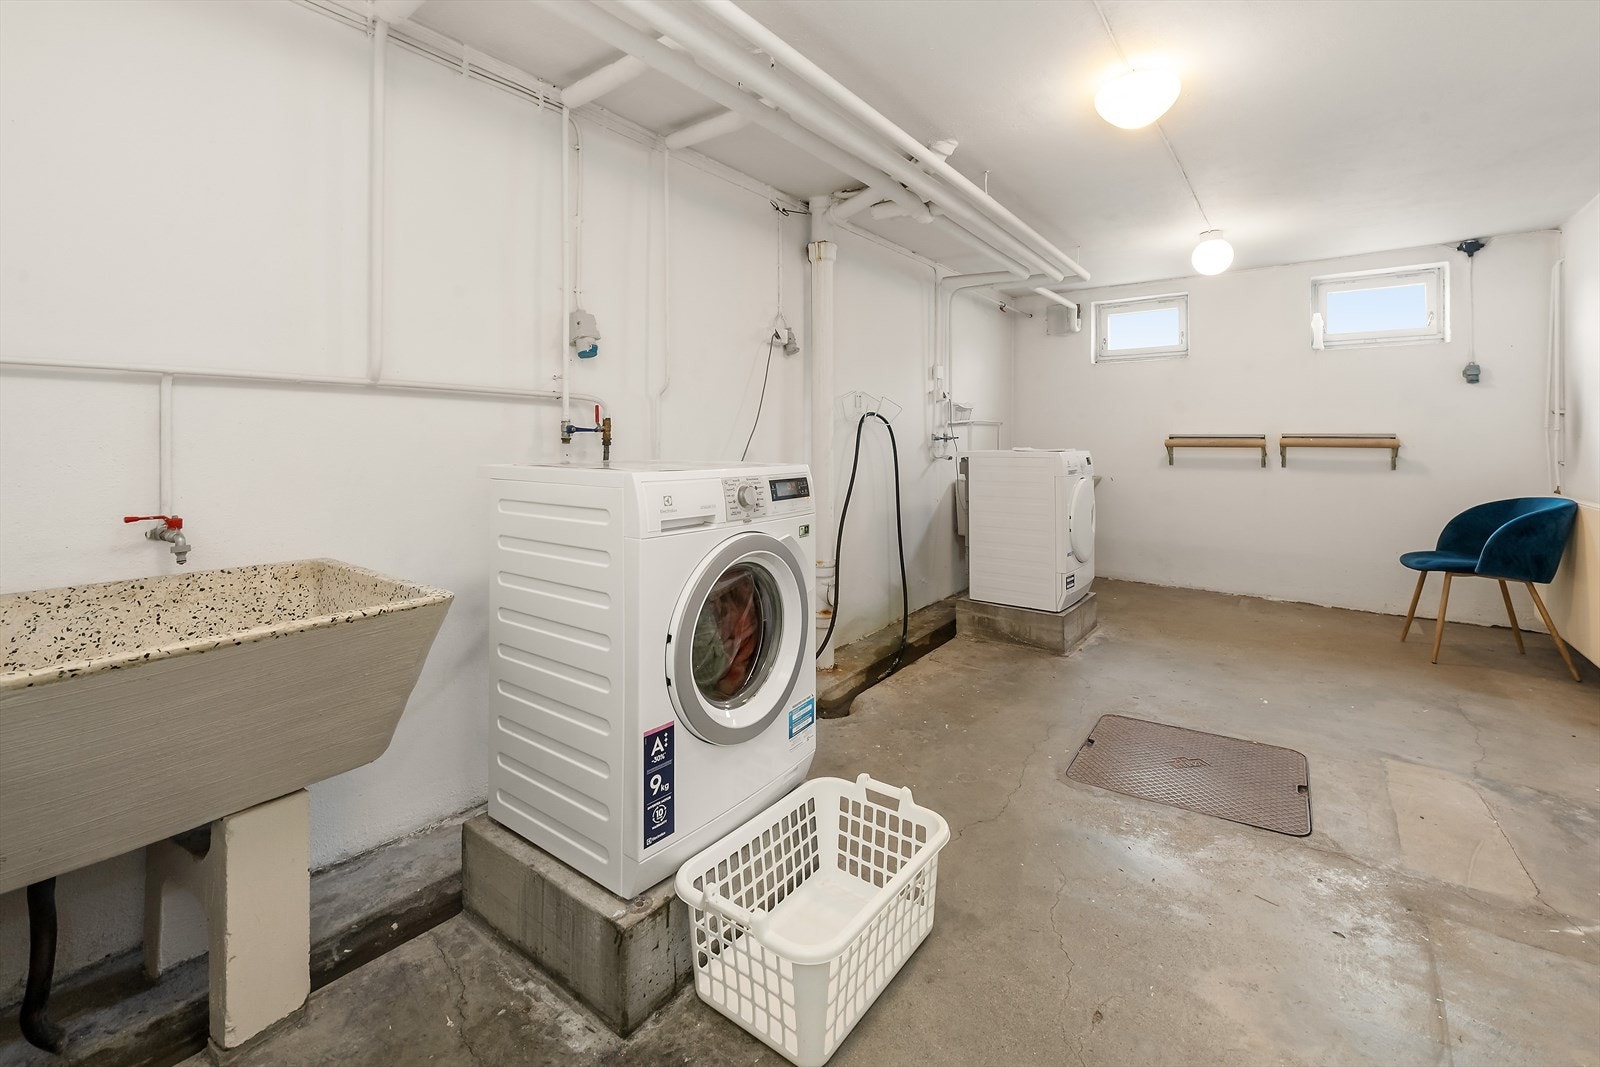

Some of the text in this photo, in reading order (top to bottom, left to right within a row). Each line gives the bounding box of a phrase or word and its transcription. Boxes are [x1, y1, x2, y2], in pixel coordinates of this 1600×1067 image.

[650, 774, 670, 796] 9 kg
[656, 808, 664, 818] 10
